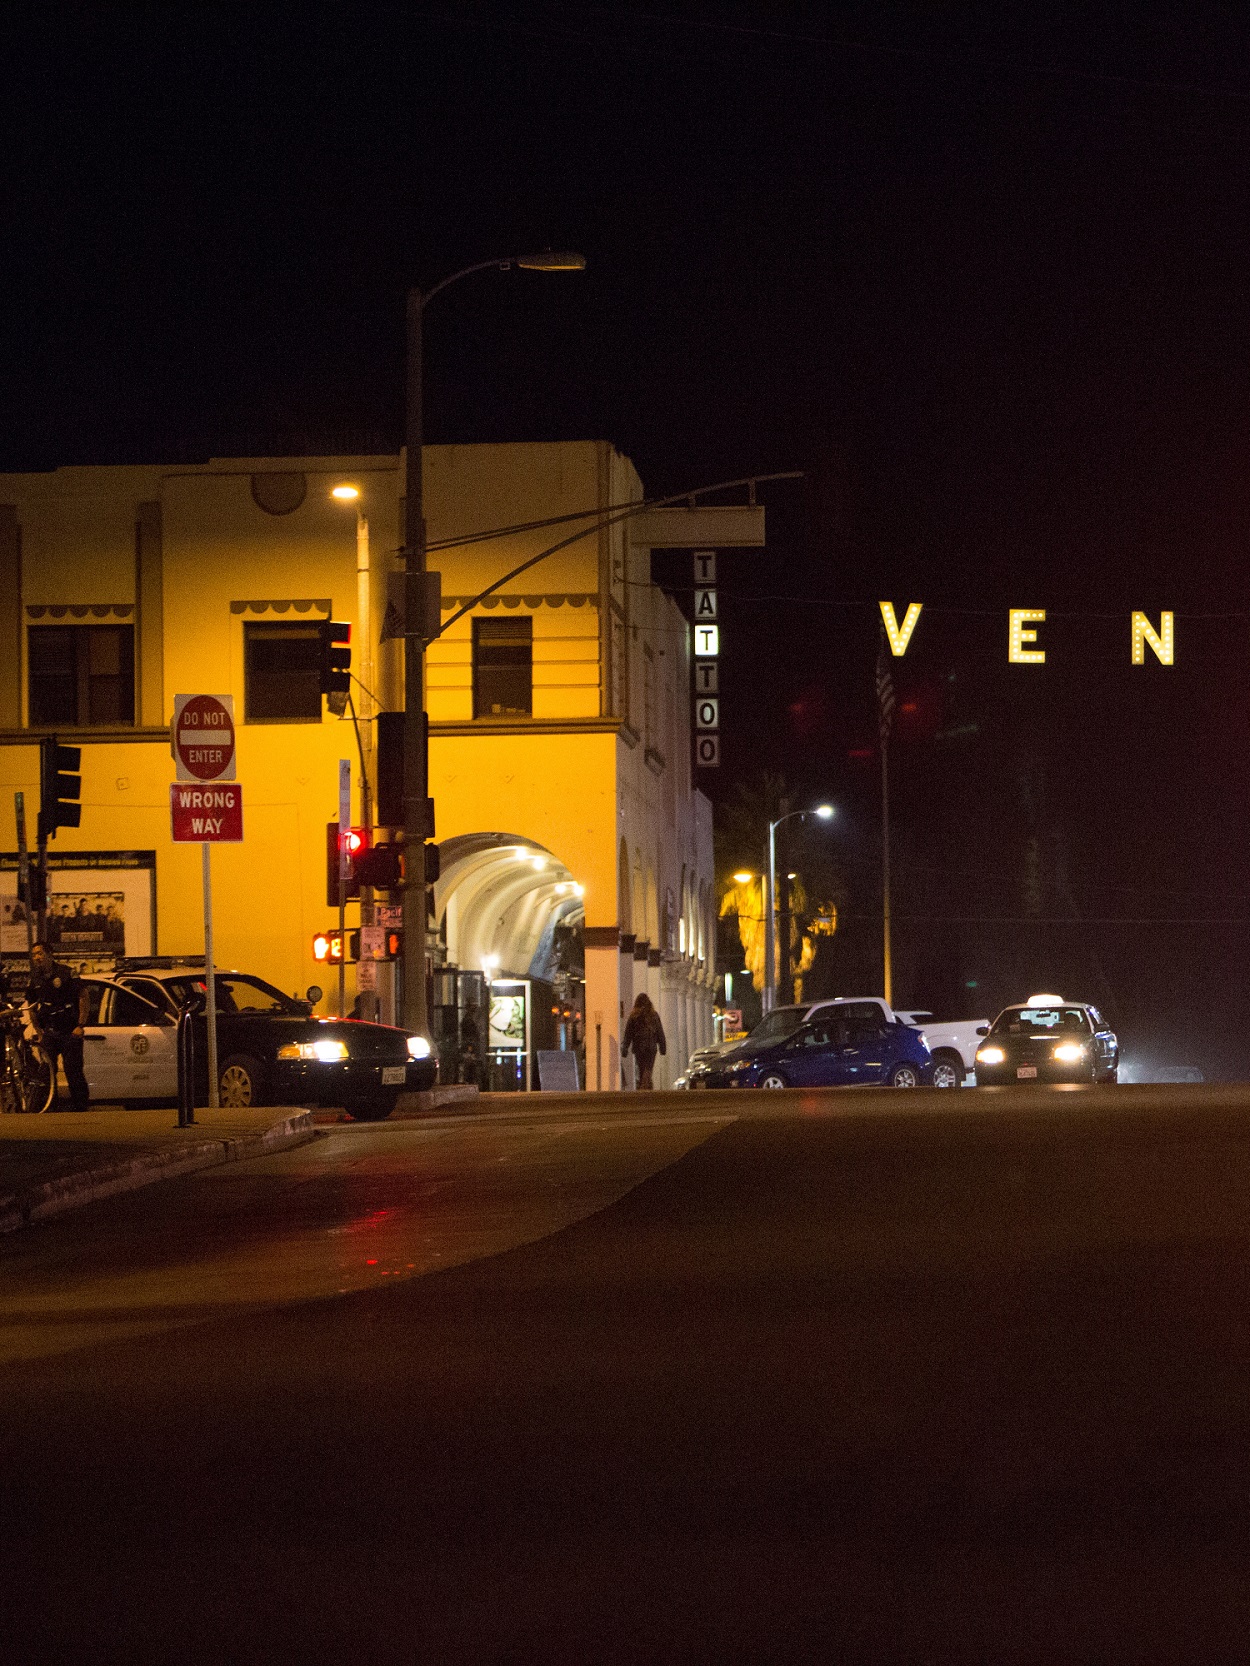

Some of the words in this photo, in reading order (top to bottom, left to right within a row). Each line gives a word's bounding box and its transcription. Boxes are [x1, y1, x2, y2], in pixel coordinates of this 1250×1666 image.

[697, 555, 716, 762] TATTOO
[184, 712, 199, 725] DO
[203, 712, 226, 725] NOT
[189, 750, 223, 763] ENTER
[179, 791, 235, 808] WRONG
[192, 818, 223, 834] WAY
